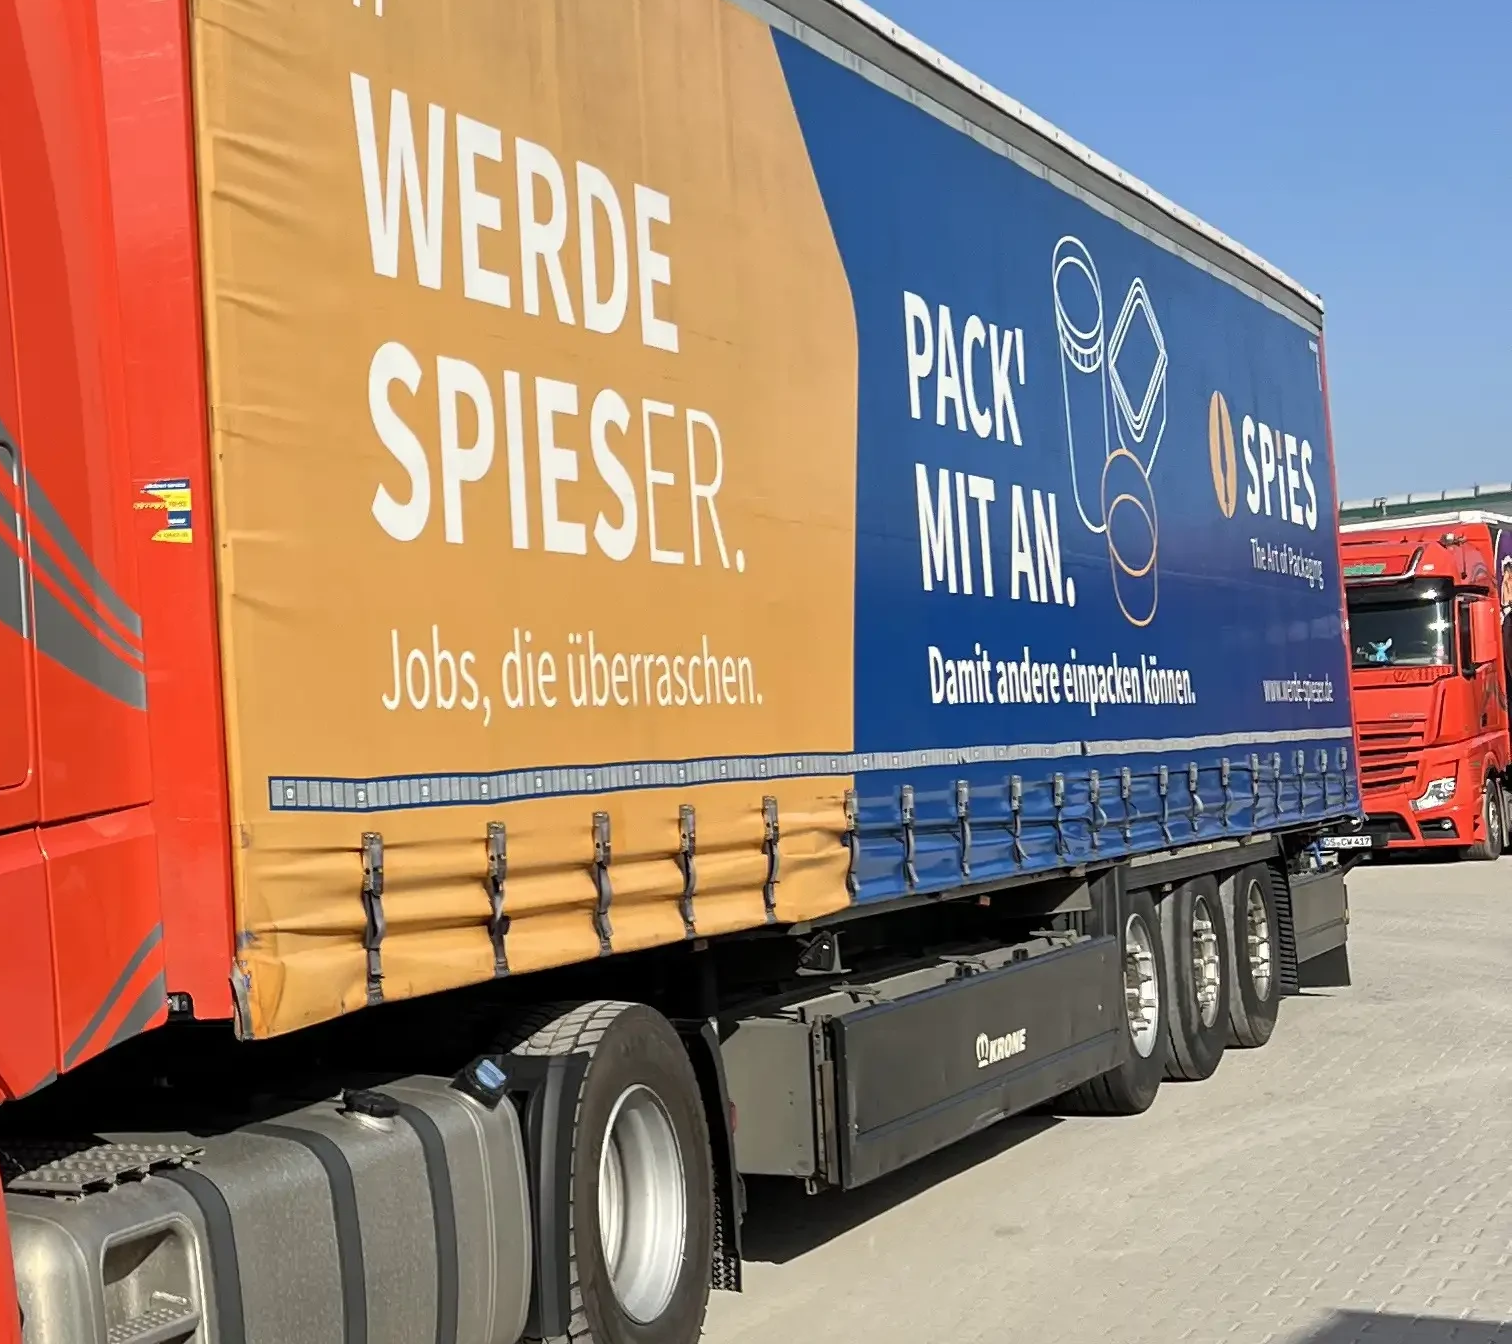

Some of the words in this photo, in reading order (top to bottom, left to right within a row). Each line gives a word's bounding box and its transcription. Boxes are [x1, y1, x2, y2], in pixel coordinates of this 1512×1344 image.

[350, 72, 679, 353] WERDE
[369, 341, 745, 572] SPIESER.
[915, 463, 995, 597] MIT
[1010, 485, 1076, 607] AN.
[1250, 538, 1266, 570] The
[1267, 542, 1280, 573] Art
[1288, 547, 1324, 590] Packaging
[382, 624, 490, 726] Jobs,
[502, 628, 557, 709] die
[568, 632, 762, 708] überraschen.
[929, 643, 994, 704] Damit
[996, 646, 1061, 704] andere
[1063, 649, 1139, 716] einpacken
[1143, 653, 1196, 704] können.
[989, 1027, 1027, 1064] KRONE
